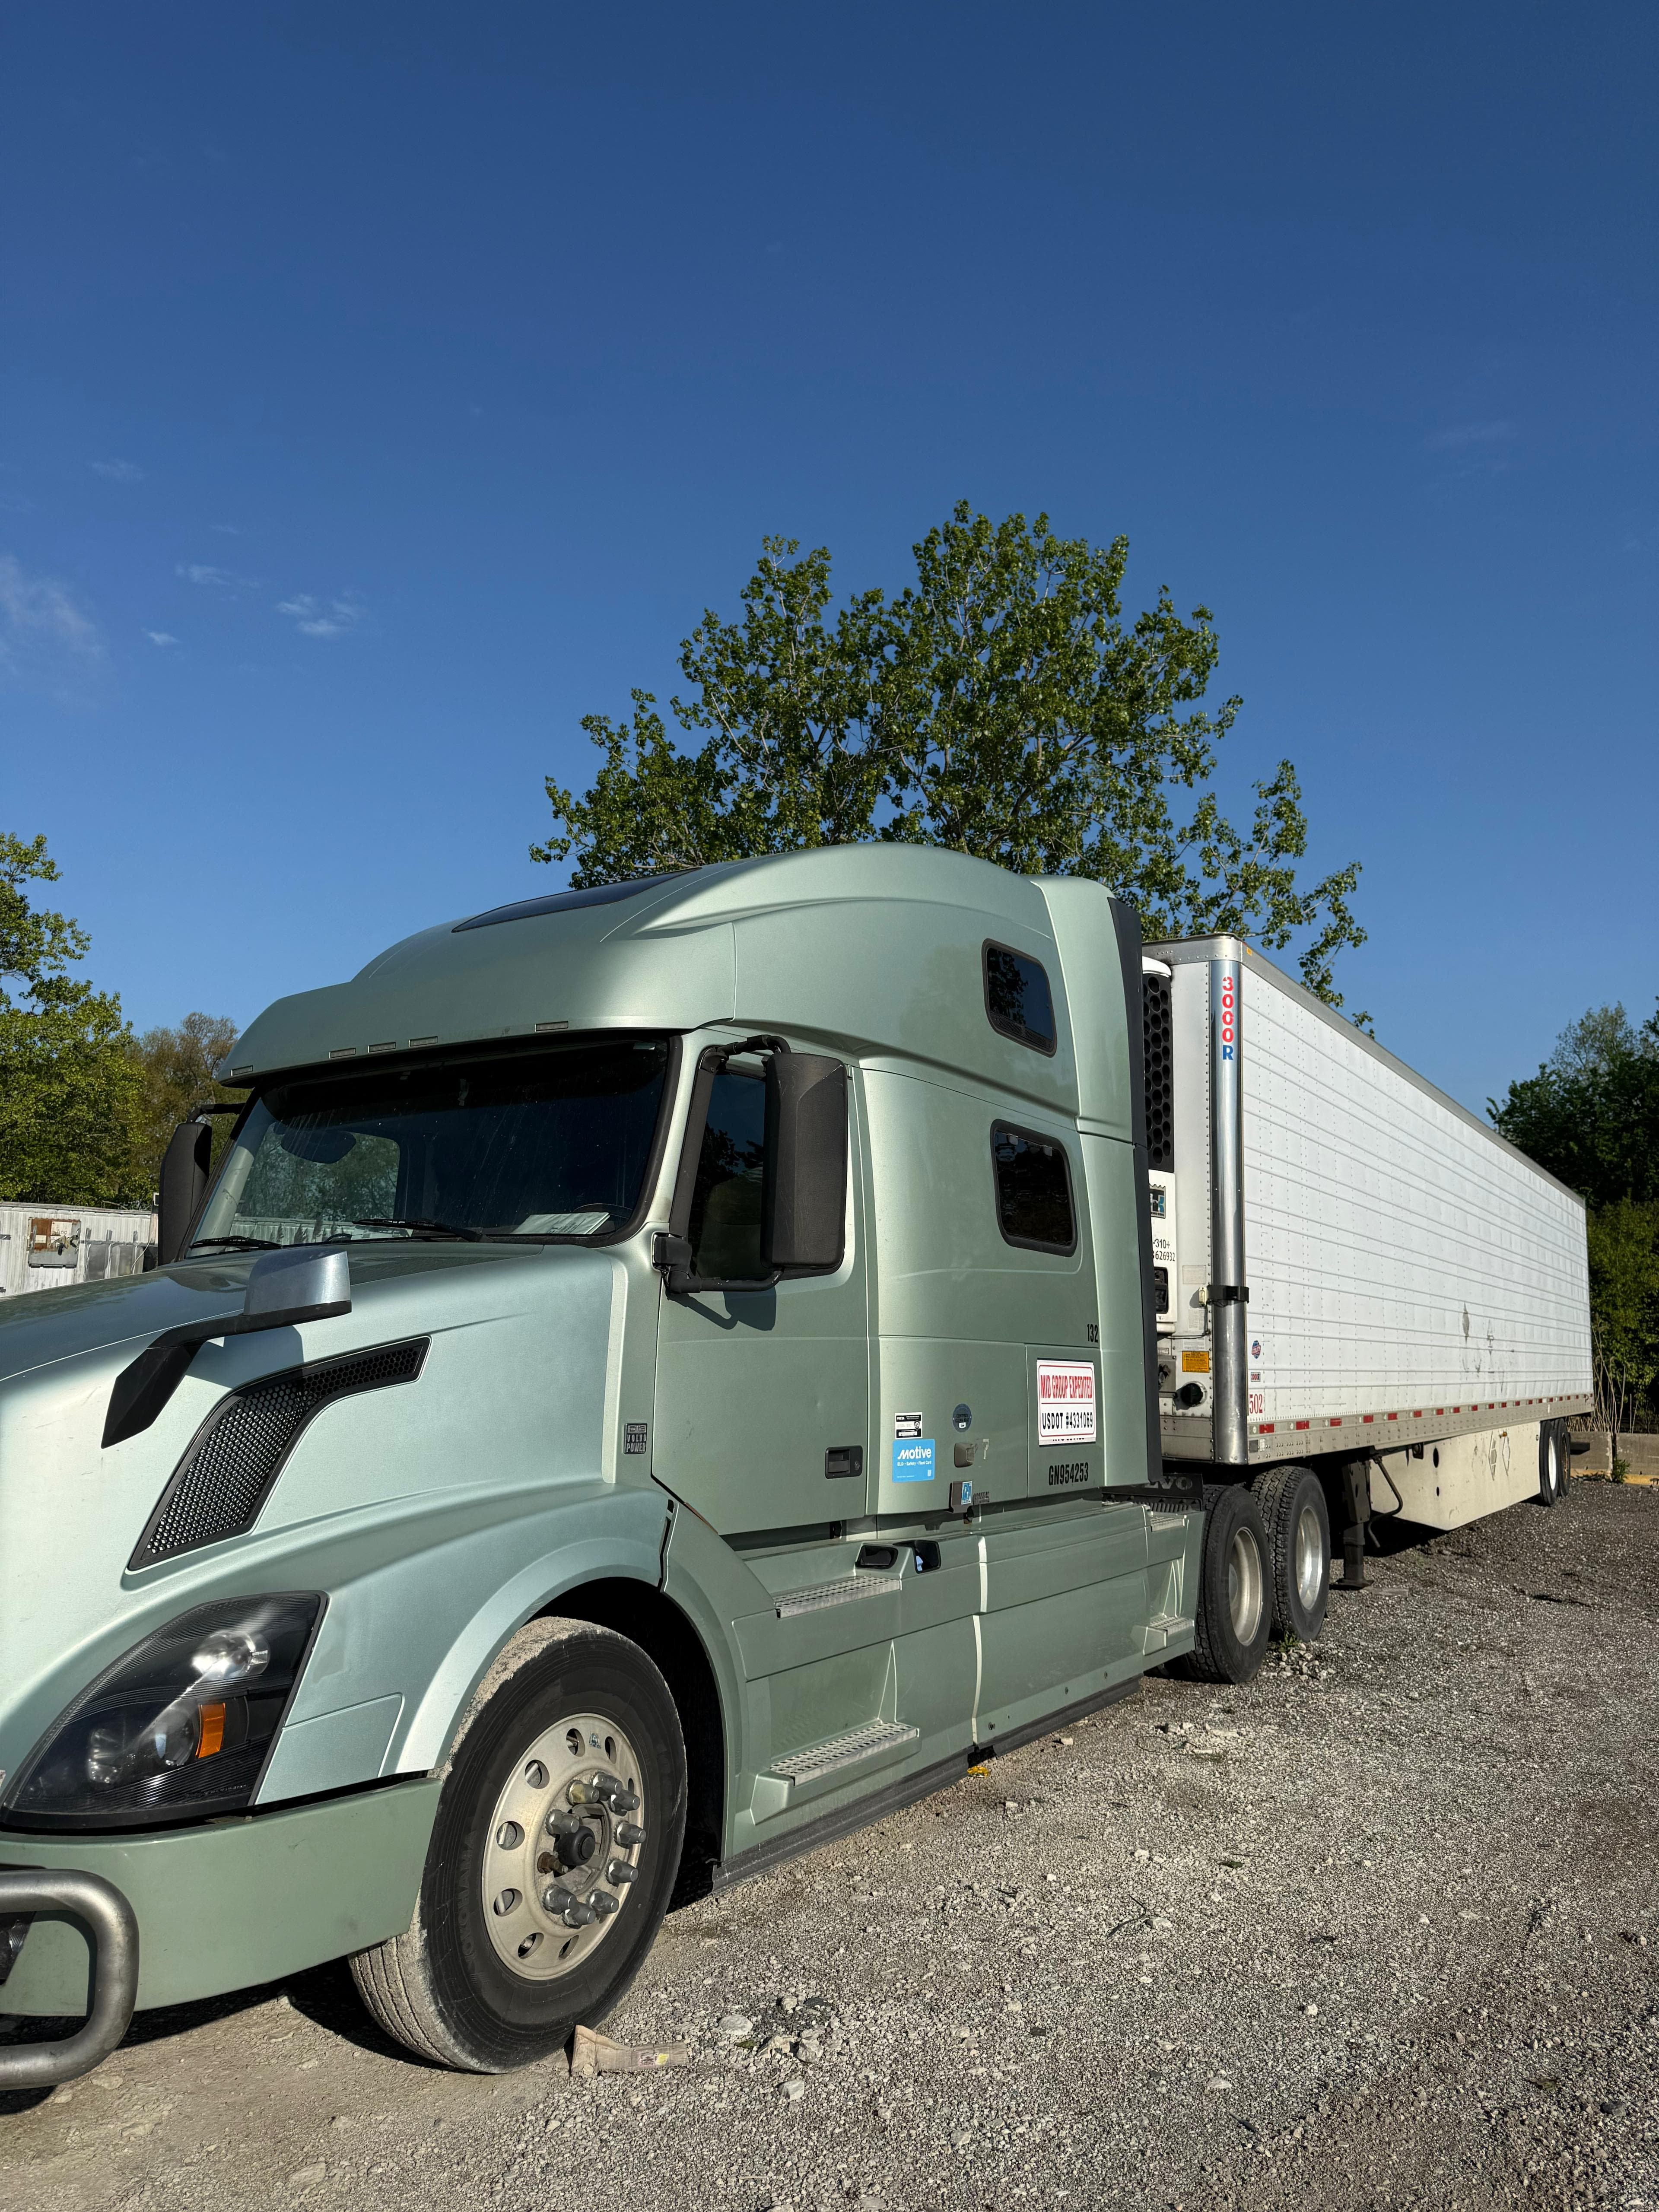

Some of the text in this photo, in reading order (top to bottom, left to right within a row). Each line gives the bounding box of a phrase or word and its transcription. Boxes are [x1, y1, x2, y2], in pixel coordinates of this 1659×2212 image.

[1222, 976, 1234, 1061] 3000R
[1087, 1323, 1098, 1343] 132
[1041, 1375, 1093, 1399] MID GROUP EXPEDITED
[1249, 1394, 1263, 1414] 502
[1042, 1412, 1093, 1430] USDOT #4331069
[626, 1443, 646, 1452] POWER
[627, 1434, 646, 1443] VOLVO
[897, 1446, 931, 1459] Motive
[1049, 1462, 1088, 1485] GN954253
